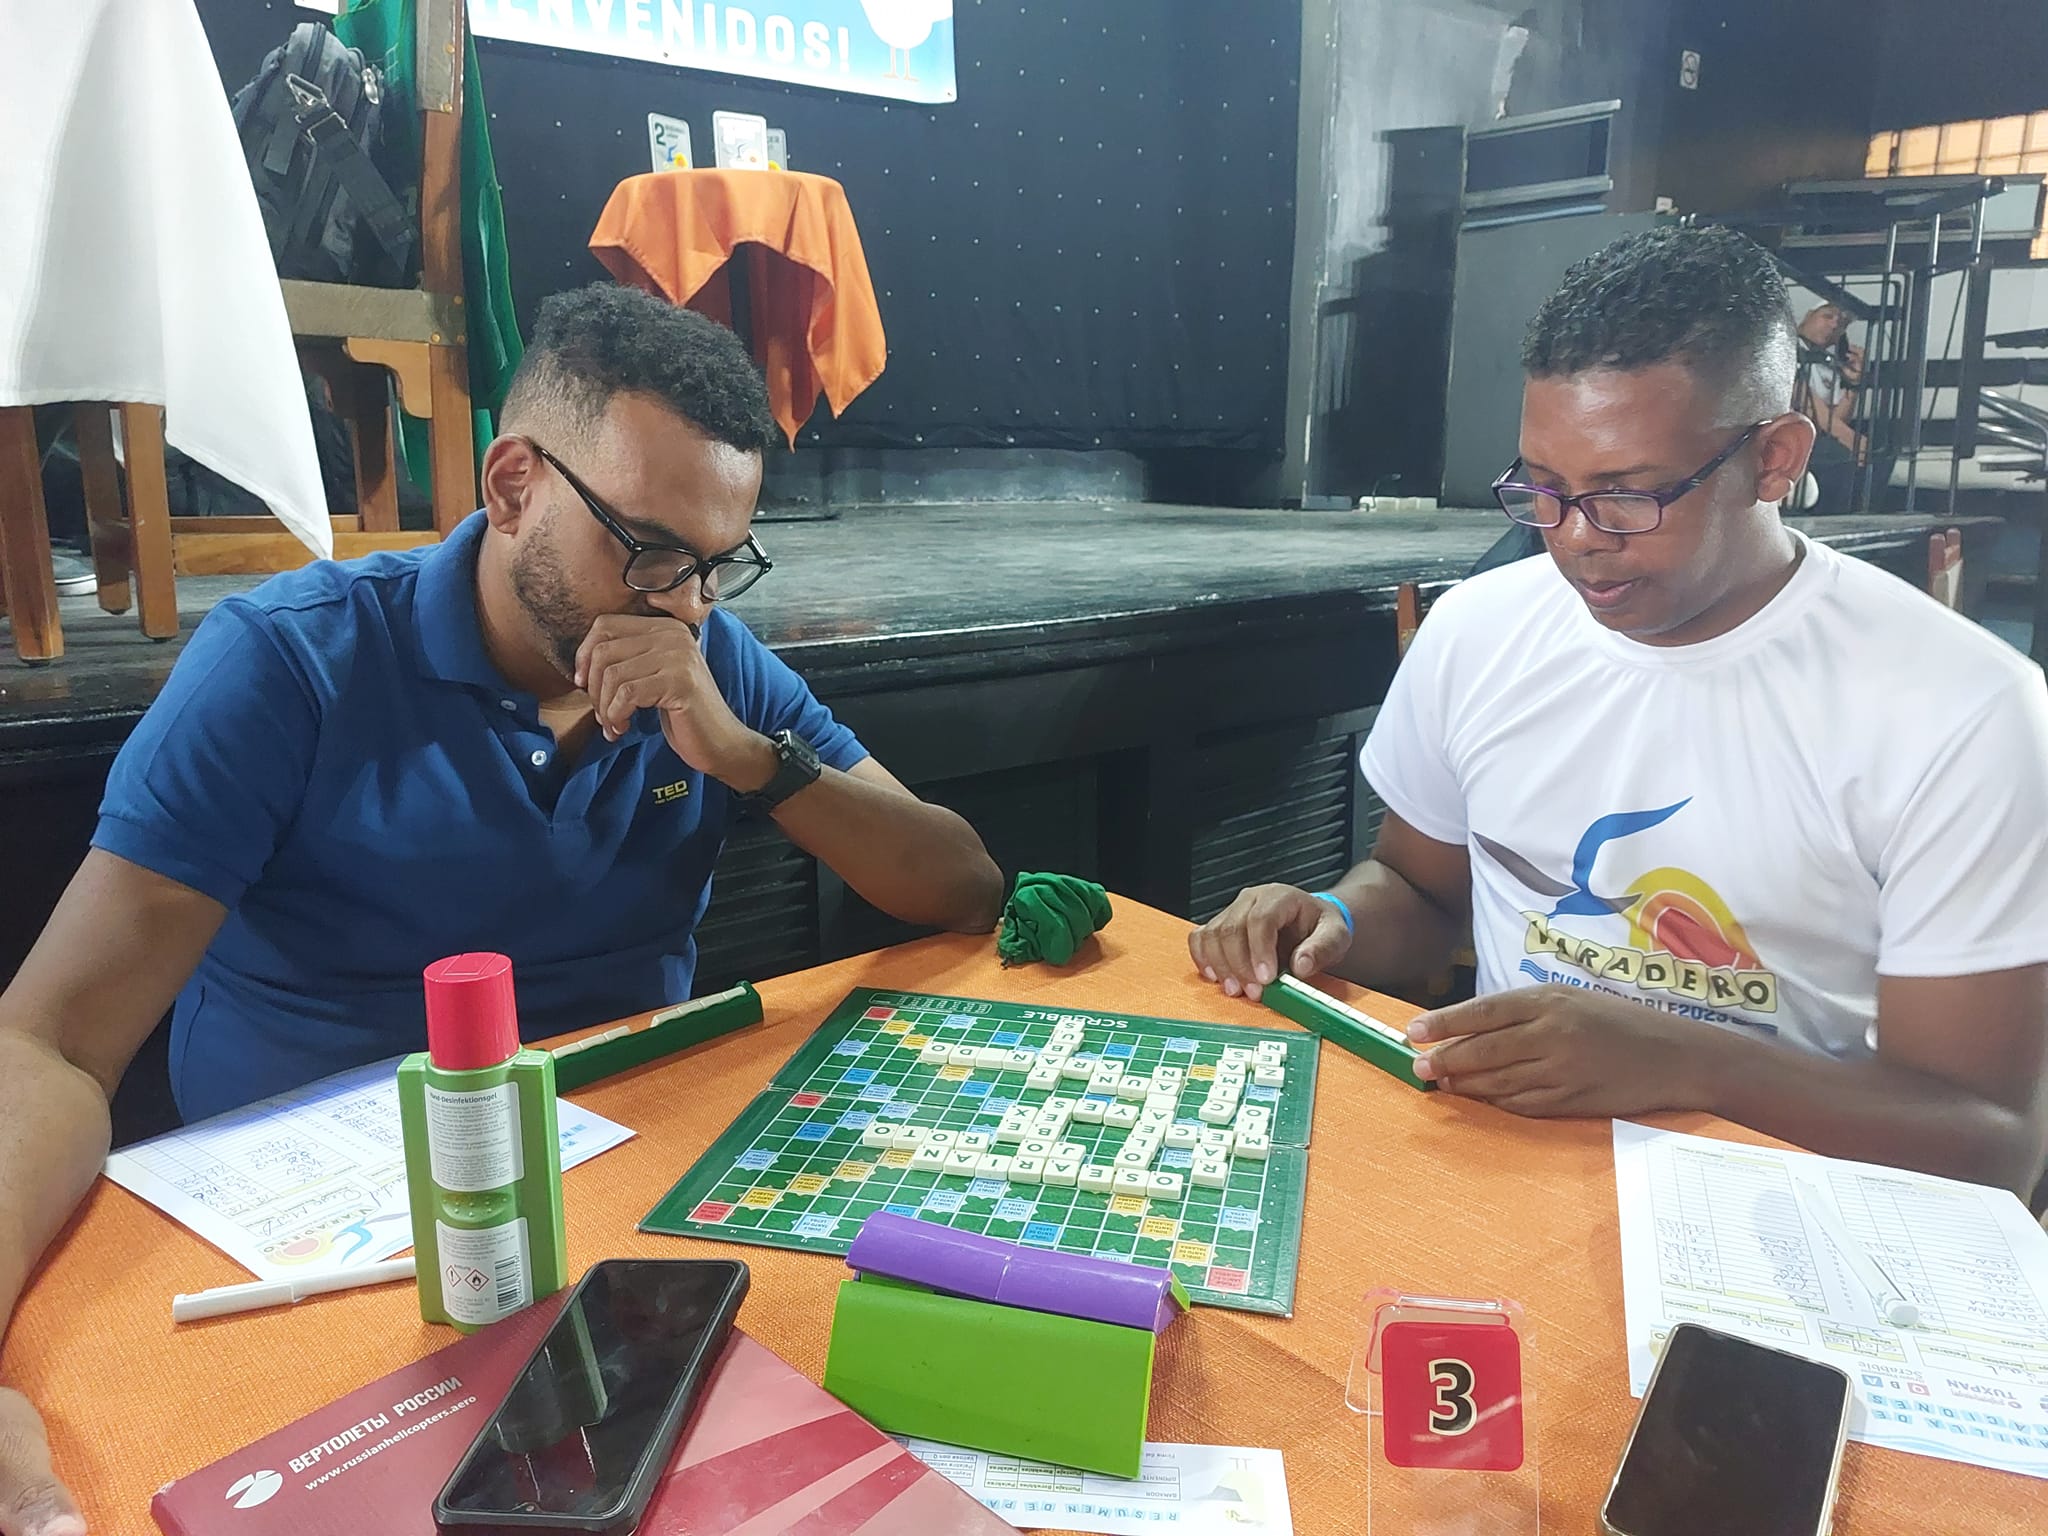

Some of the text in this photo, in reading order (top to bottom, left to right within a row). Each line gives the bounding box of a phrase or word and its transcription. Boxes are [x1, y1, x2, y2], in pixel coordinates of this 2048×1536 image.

[654, 122, 667, 146] 2
[652, 780, 688, 800] TED
[1531, 918, 1770, 1005] VARADERO
[1428, 1357, 1478, 1437] 3
[1945, 1378, 2017, 1401] TUXPAN
[288, 1376, 463, 1474] ВЕРТОЛЕТЫ РОССИИ
[304, 1395, 477, 1490] www.russianhelicopters.aero
[1026, 1502, 1052, 1513] DE
[1068, 1503, 1177, 1521] RESUMEN
